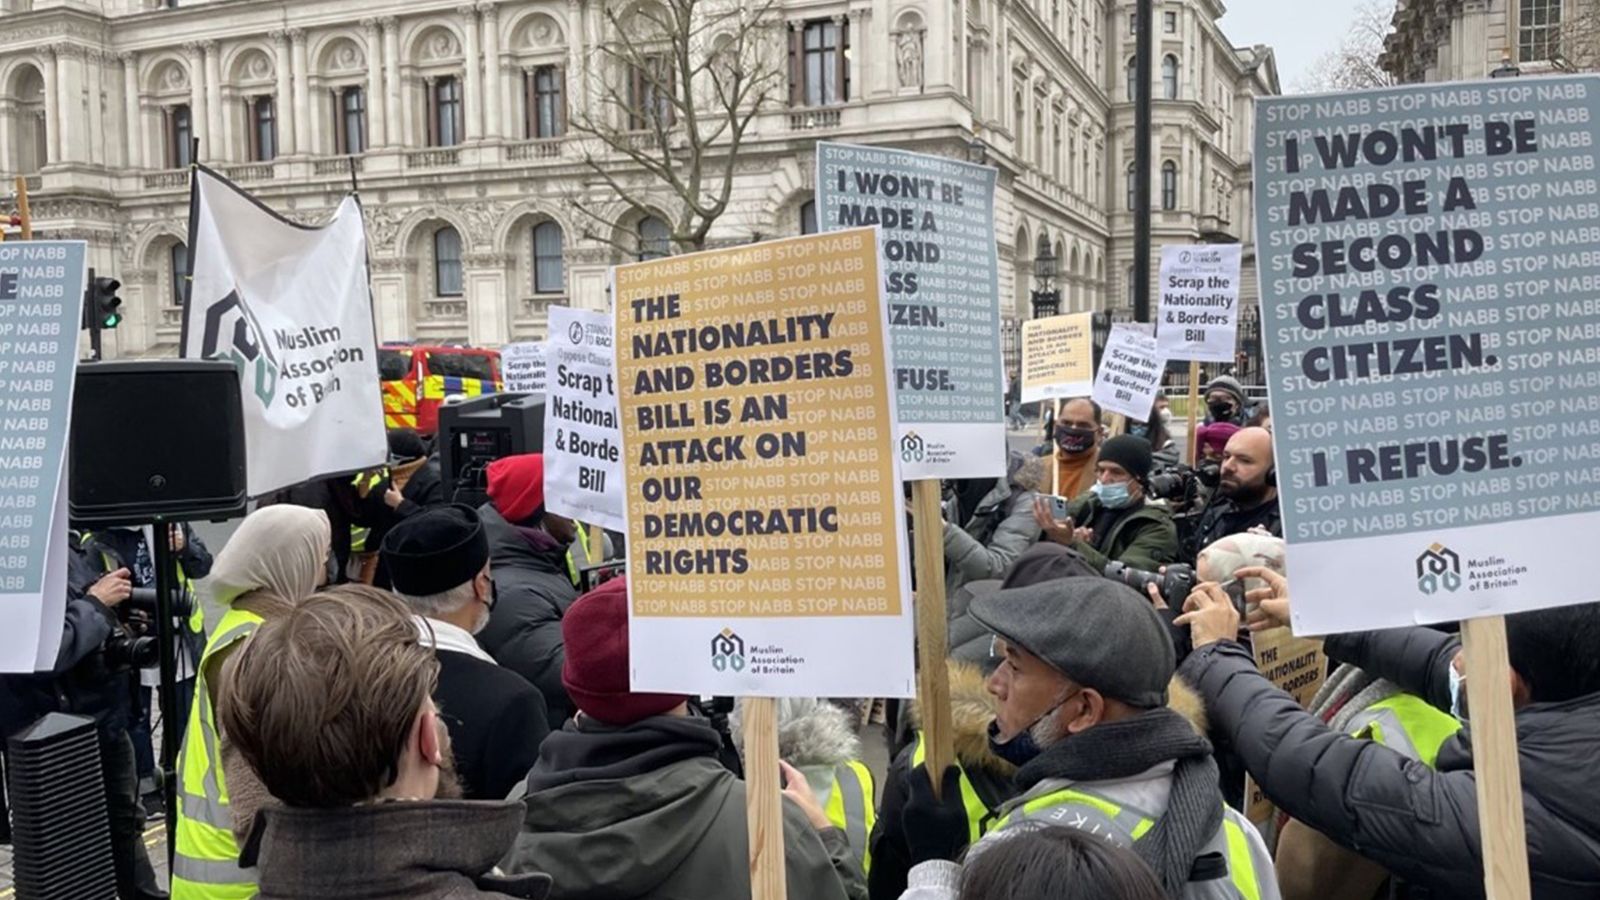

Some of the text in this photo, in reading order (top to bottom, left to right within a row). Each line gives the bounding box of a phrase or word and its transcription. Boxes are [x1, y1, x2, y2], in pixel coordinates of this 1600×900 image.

[1266, 83, 1586, 122] STOP NABB STOP NABB STOP NABB
[1285, 119, 1538, 173] I WON'T BE
[825, 148, 987, 181] STOP NABB STOP NABB STOP NABB
[838, 170, 964, 206] I WON'T BE
[1288, 177, 1476, 226] MADE A
[838, 204, 938, 233] MADE A
[0, 247, 66, 260] OP NABB
[619, 235, 863, 284] STOP NABB STOP NABB STOP NABB
[885, 240, 940, 263] OND
[1292, 229, 1484, 278] SECOND
[22, 266, 65, 279] NABB
[694, 276, 728, 292] STOP
[732, 271, 773, 287] NABB
[777, 262, 816, 281] STOP
[820, 258, 864, 275] NABB
[1169, 275, 1230, 291] Scrap the
[20, 285, 64, 298] NABB
[1164, 293, 1233, 310] Nationality
[18, 304, 62, 316] NABB
[631, 294, 681, 323] THE
[1166, 311, 1229, 325] & Borders
[1297, 284, 1440, 330] CLASS
[16, 323, 60, 335] NABB
[633, 312, 835, 359] NATIONALITY
[1185, 329, 1205, 341] Bill
[14, 341, 58, 354] NABB
[1301, 333, 1498, 382] CITIZEN.
[12, 360, 56, 373] NABB
[1112, 349, 1140, 366] Scrap
[1141, 358, 1157, 370] the
[558, 364, 602, 398] Scrap
[634, 366, 695, 395] AND
[705, 350, 854, 388] BORDERS
[896, 368, 955, 391] FUSE.
[1103, 373, 1151, 395] & Borders
[1105, 360, 1157, 385] Nationality
[9, 379, 53, 392] NABB
[285, 386, 308, 408] of
[517, 382, 546, 391] Border
[1115, 389, 1132, 401] Bill
[7, 398, 51, 411] NABB
[553, 395, 618, 429] National
[637, 394, 788, 431] BILL IS AN
[556, 428, 619, 462] & Borde
[639, 431, 806, 466] ATTACK ON
[1312, 434, 1523, 487] I REFUSE.
[579, 466, 606, 493] Bill
[642, 476, 703, 503] OUR
[1295, 472, 1564, 514] STOP NABB STOP NABB STOP
[644, 506, 839, 538] DEMOCRATIC
[1297, 496, 1561, 538] STOP NABB STOP NABB STOP
[646, 548, 749, 575] RIGHTS
[1467, 556, 1506, 568] Muslim
[1469, 565, 1528, 580] Association
[1470, 577, 1518, 591] of Britain
[636, 598, 887, 613] STOP NABB STOP NABB STOP NABB
[750, 646, 783, 654] Muslim
[750, 655, 804, 665] Association
[1261, 647, 1278, 664] THE
[751, 665, 795, 674] of Britain
